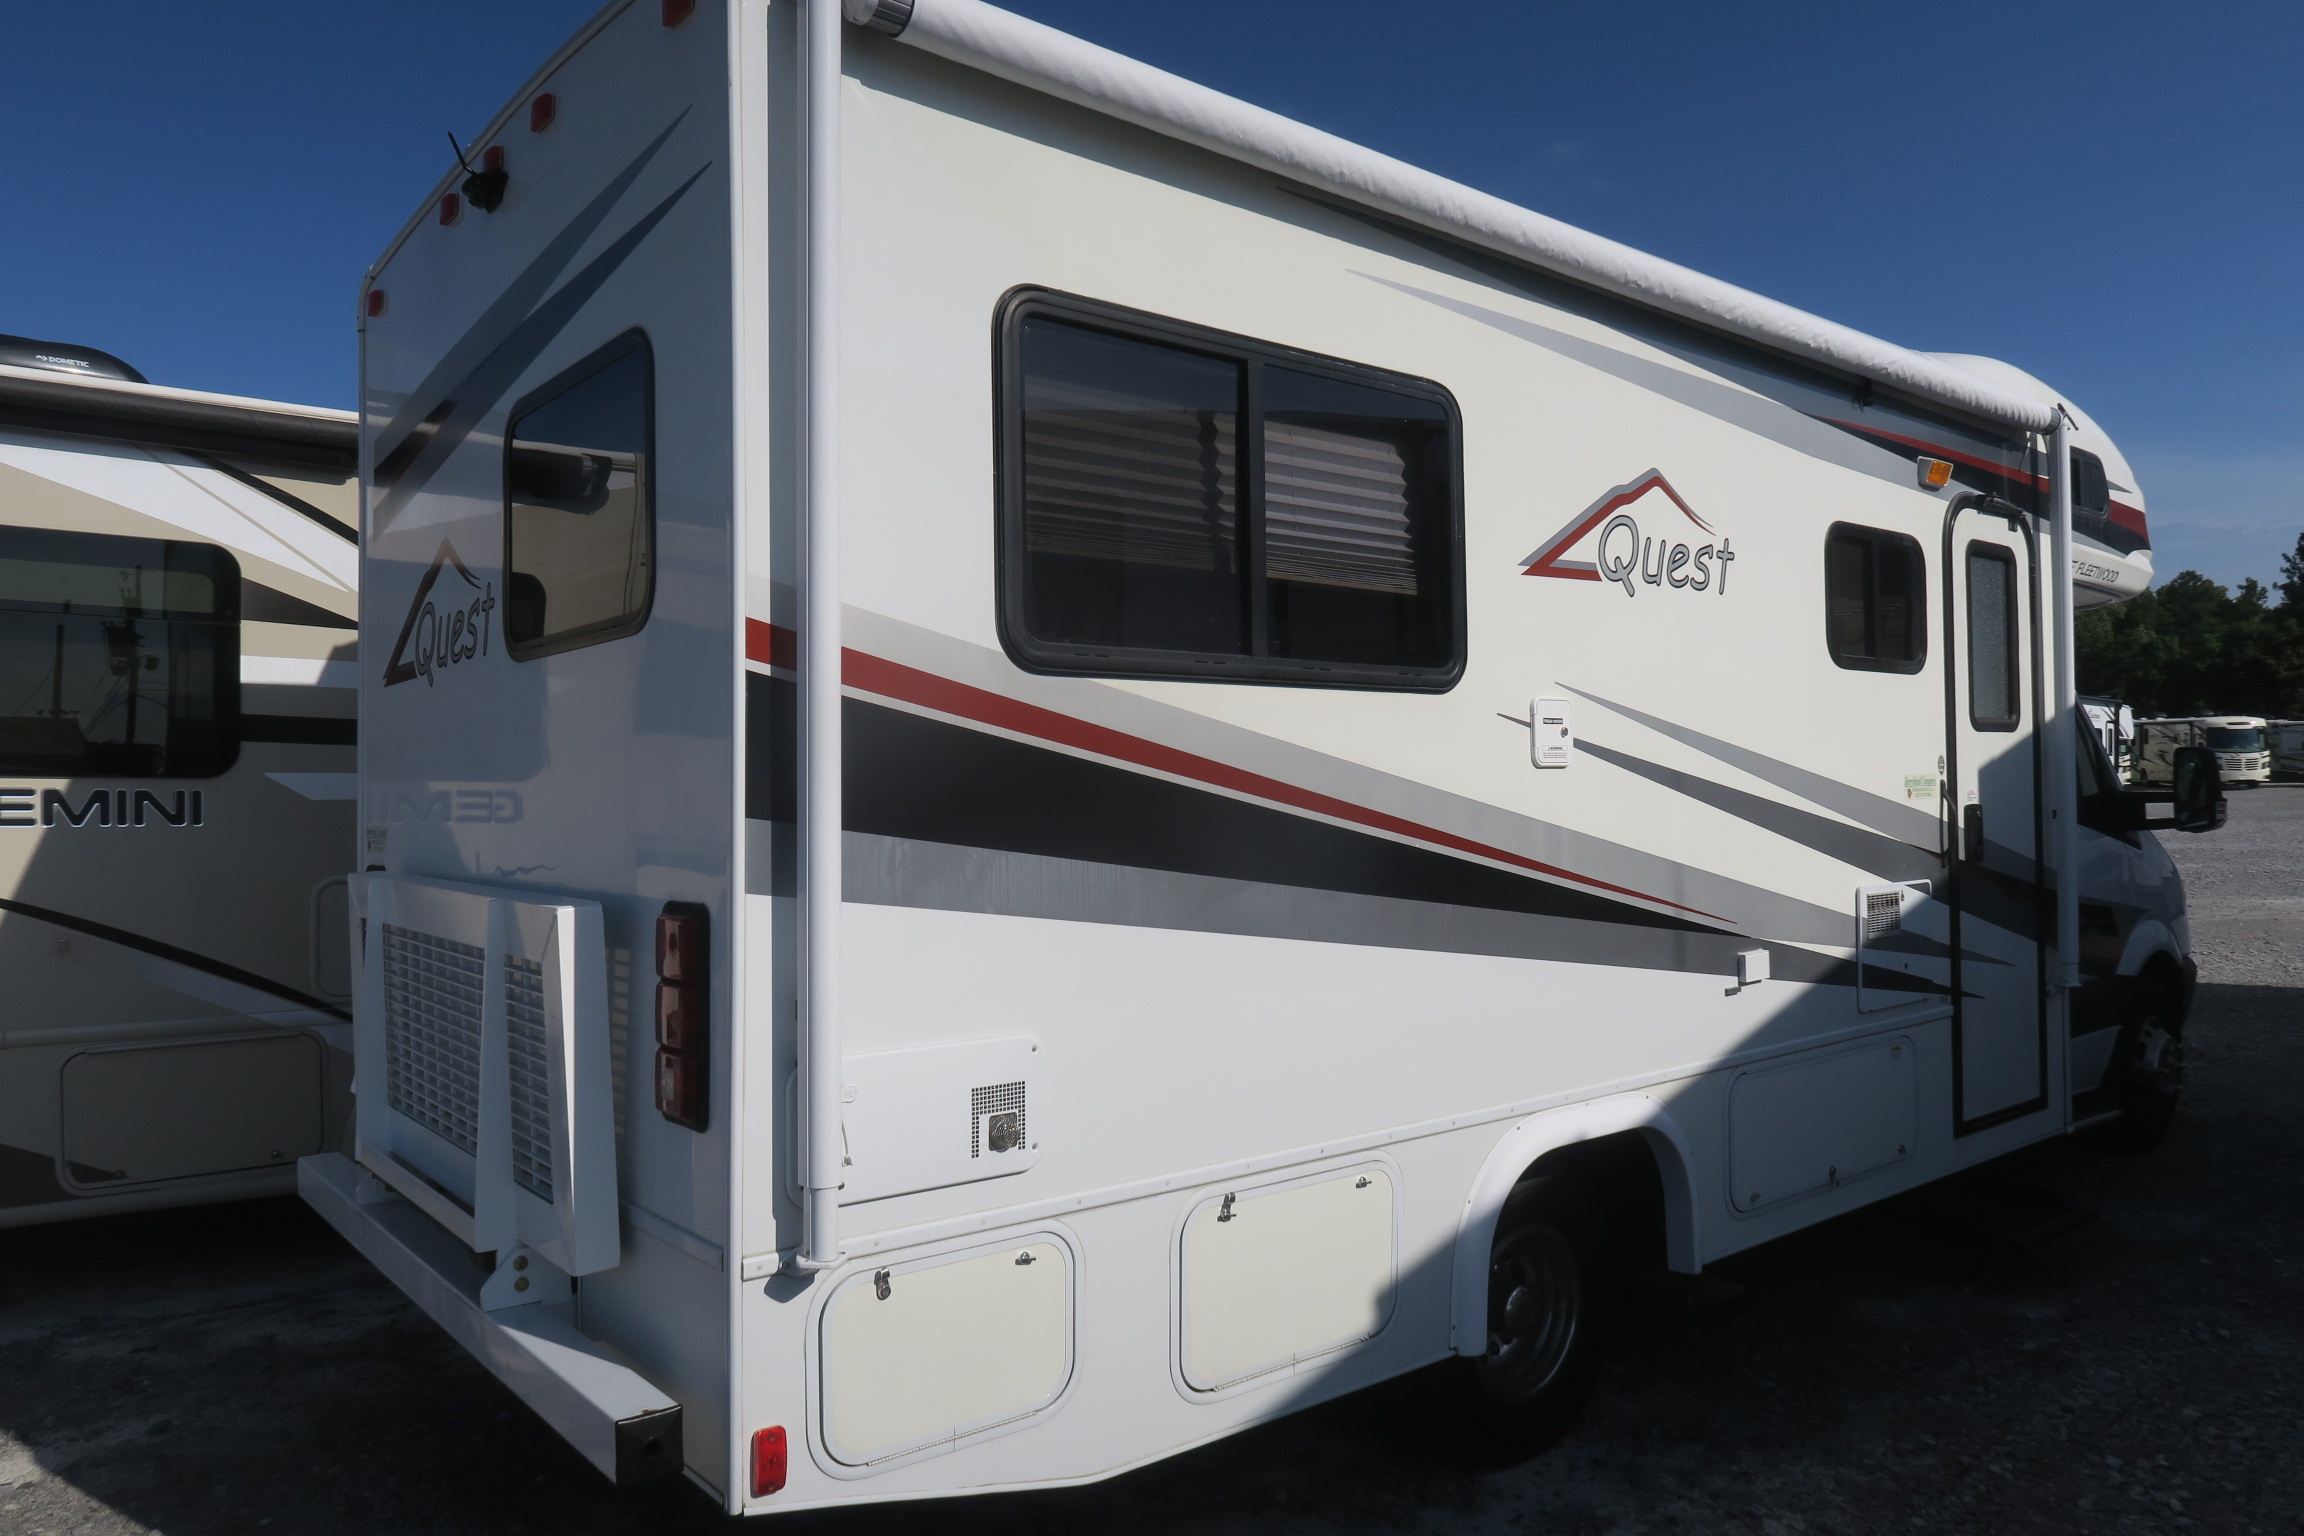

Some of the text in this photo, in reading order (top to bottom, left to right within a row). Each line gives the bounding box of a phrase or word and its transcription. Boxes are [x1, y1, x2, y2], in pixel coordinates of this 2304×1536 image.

[48, 356, 90, 368] DOMETIC
[1598, 514, 1735, 598] Quest
[2075, 562, 2120, 583] FLEETWOOD
[415, 581, 495, 687] Quest
[0, 788, 204, 827] EMINI
